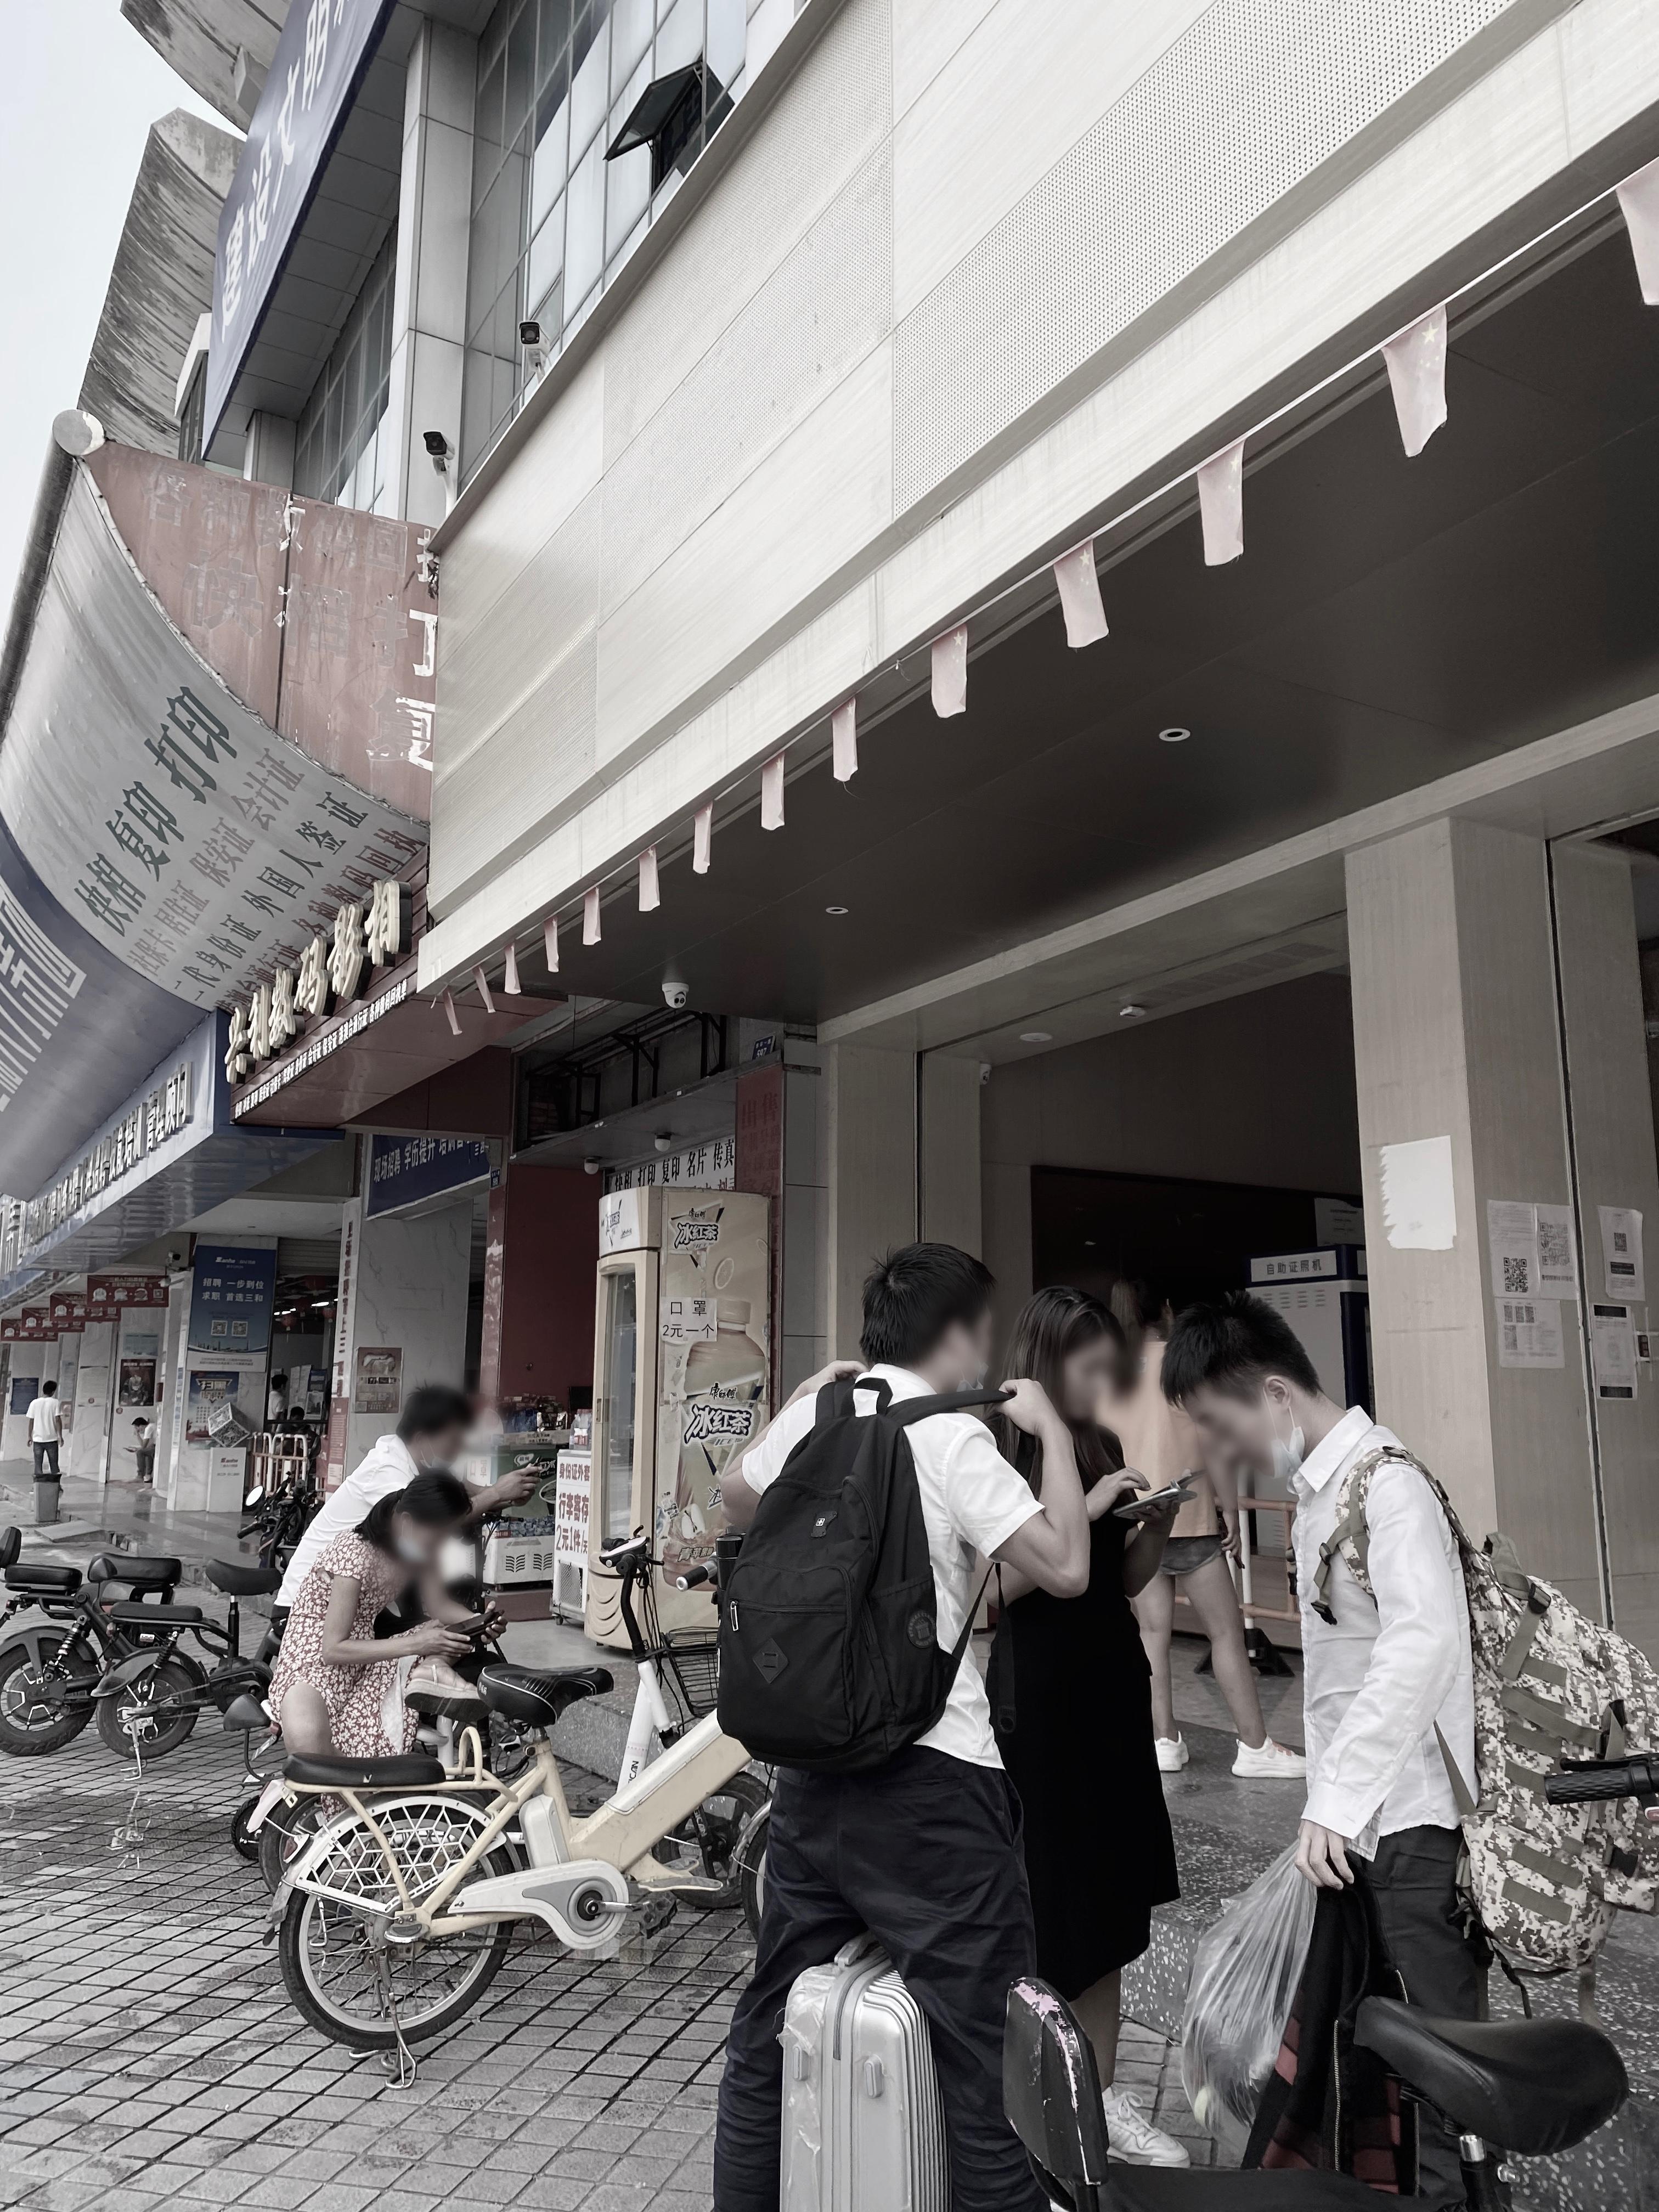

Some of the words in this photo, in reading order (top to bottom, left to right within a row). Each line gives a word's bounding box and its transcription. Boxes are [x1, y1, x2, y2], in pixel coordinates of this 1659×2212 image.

[144, 686, 237, 804] 打印
[105, 781, 184, 882] 复印
[126, 928, 177, 977] 社保卡
[153, 879, 210, 937] 居住证
[189, 816, 256, 888] 保安证
[230, 748, 305, 831] 会计证
[240, 791, 369, 918] 外国人签证
[75, 853, 146, 937] 快相
[374, 1148, 400, 1182] 现场招聘
[404, 1137, 436, 1170] 学历提升
[637, 1164, 656, 1187] 打印
[662, 1156, 680, 1184] 复印
[687, 1148, 707, 1178] 名片
[713, 1138, 734, 1171] 传真
[674, 1223, 719, 1249] 冰红茶
[202, 1277, 222, 1287] 招聘
[226, 1279, 264, 1290] 一步到位
[1266, 1259, 1322, 1276] 自助证照机
[201, 1291, 221, 1301] 求职
[225, 1292, 264, 1303] 首选三和
[662, 1323, 714, 1339] 2元一个
[684, 1403, 752, 1444] 冰红茶
[558, 1463, 590, 1482] 身份证外套
[558, 1492, 589, 1523] 行李寄存
